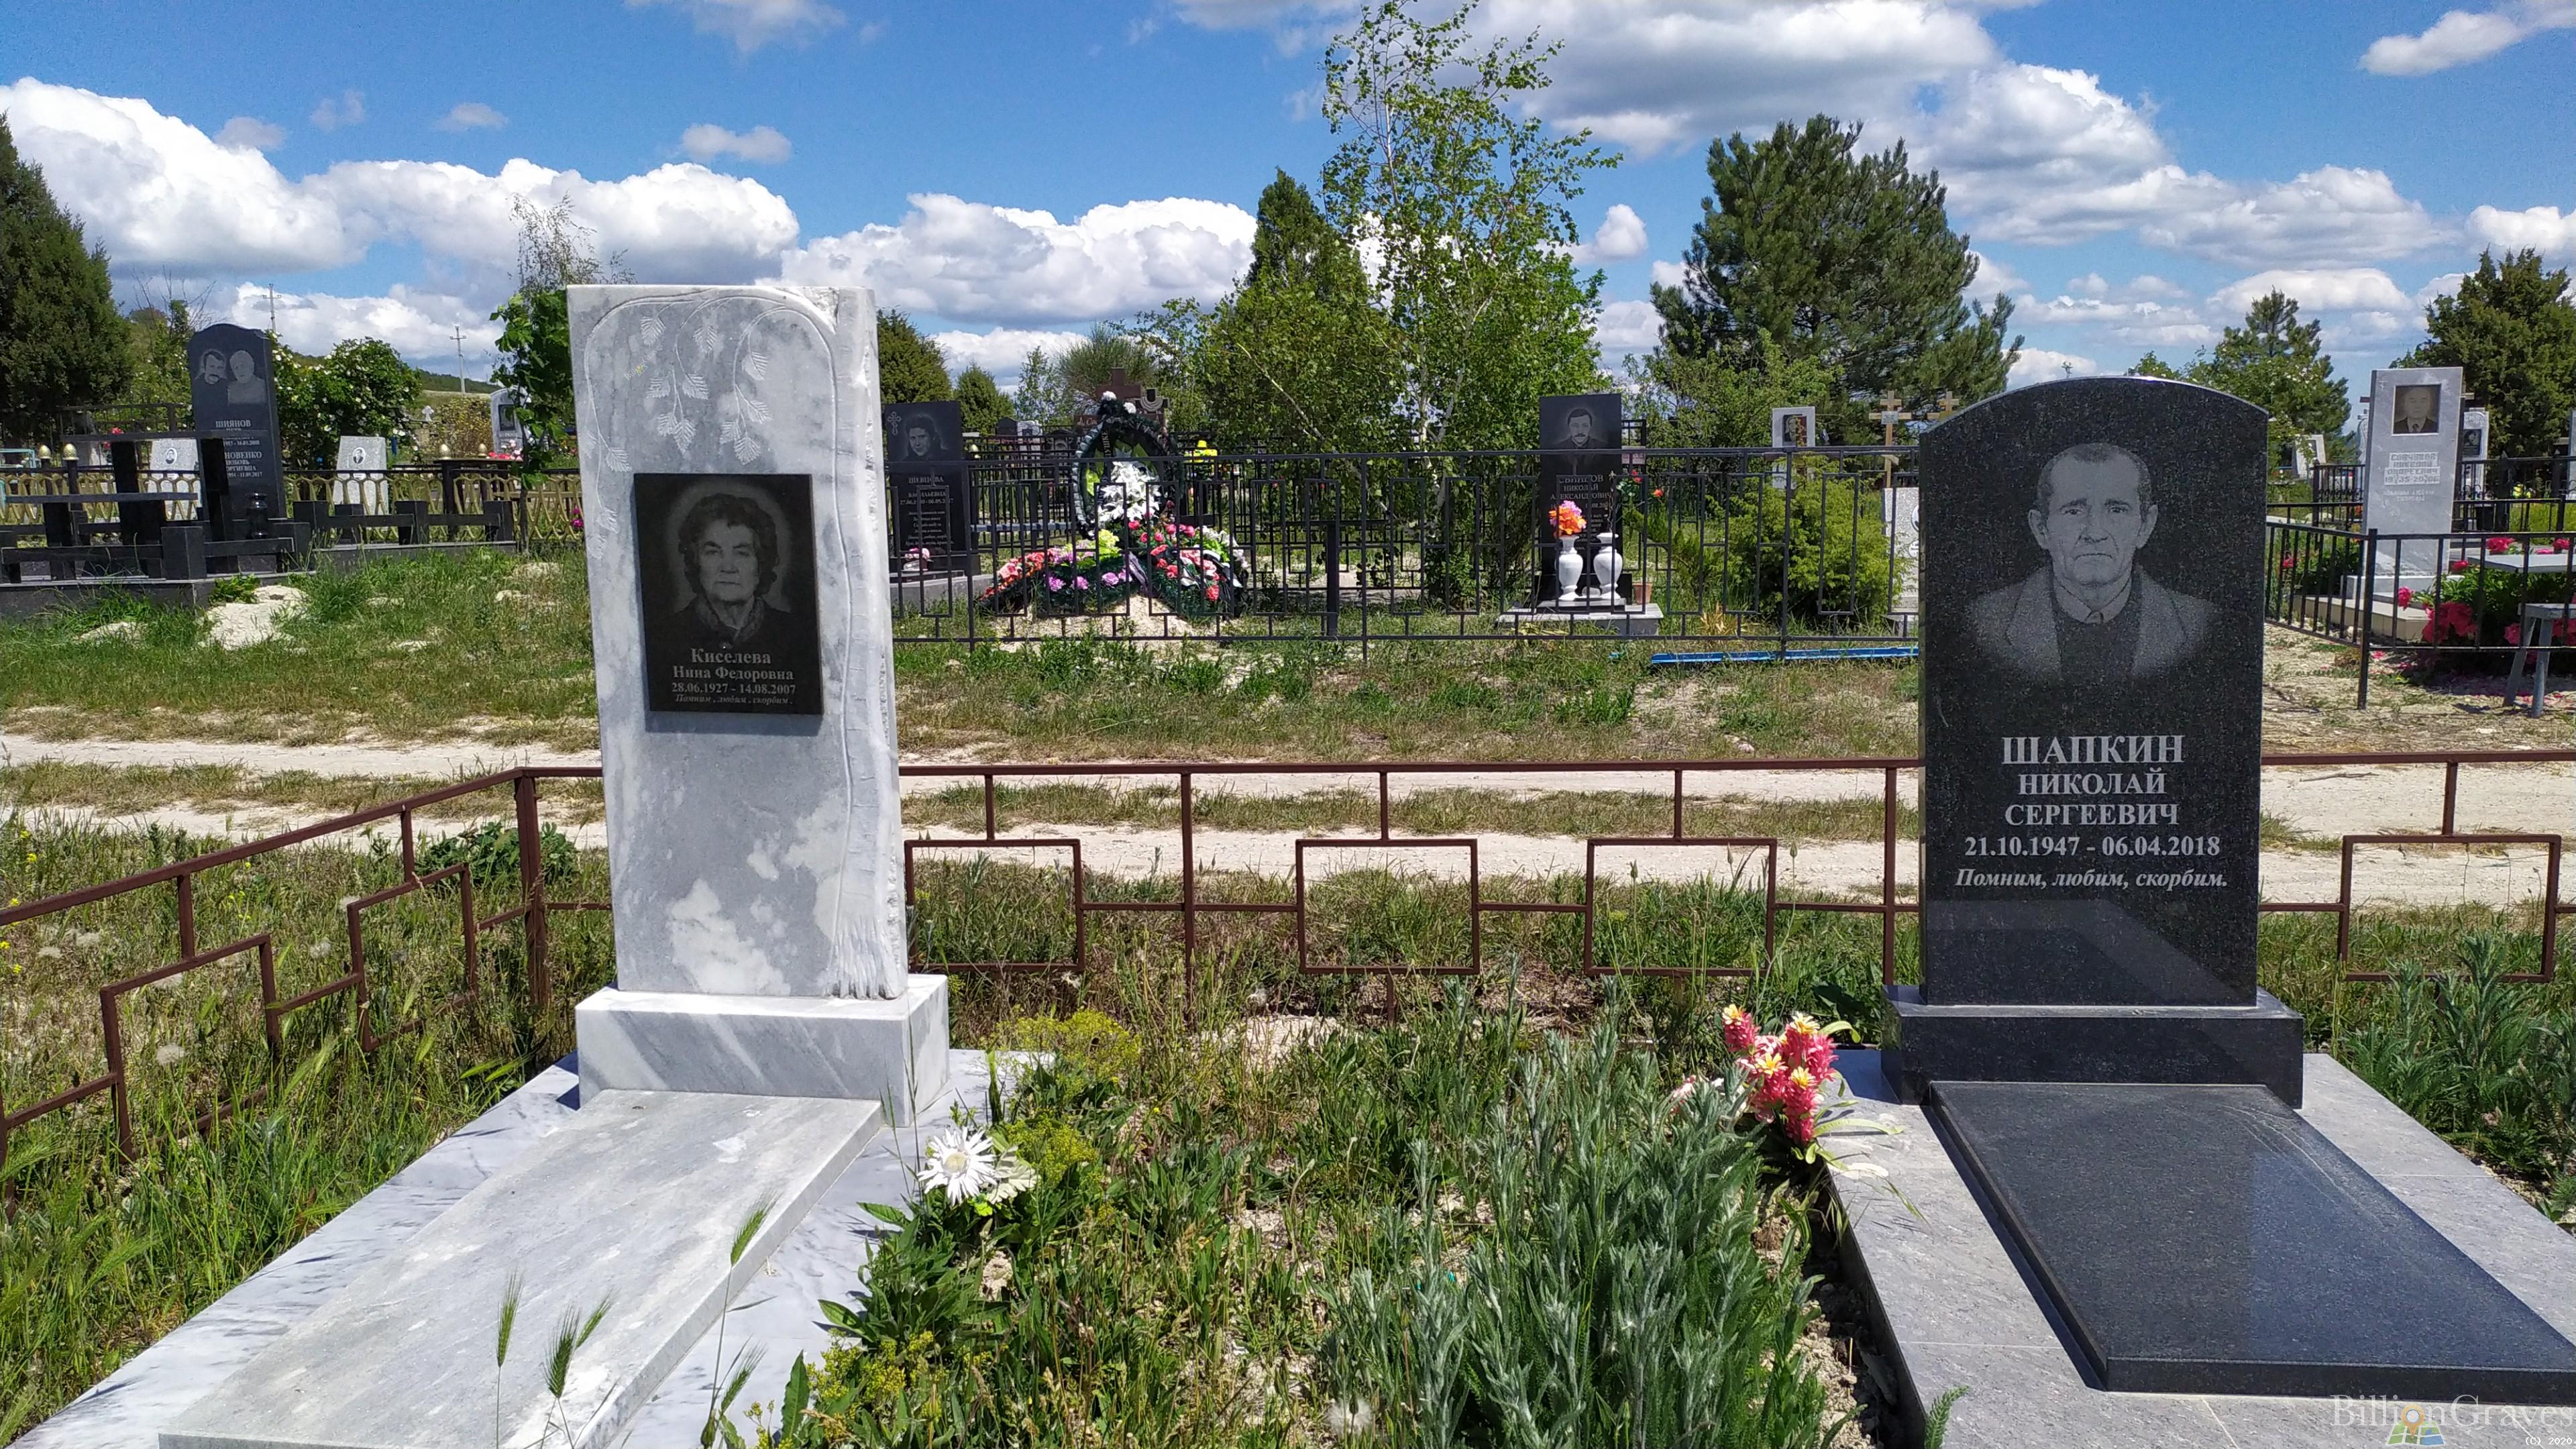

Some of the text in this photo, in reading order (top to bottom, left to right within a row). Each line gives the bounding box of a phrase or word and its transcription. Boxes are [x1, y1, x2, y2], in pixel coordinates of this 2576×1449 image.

[215, 420, 252, 428] ШИЯНОВ
[224, 451, 262, 459] НОВЕНКО
[1564, 483, 1599, 492] НИКОЛЙ
[1551, 492, 1612, 500] АЕКСАНДОВИЧ
[691, 648, 771, 663] Киселева
[673, 665, 794, 682] Нина Федоровна
[672, 682, 728, 692] 28.06.1927
[740, 684, 796, 694] 14.08.2007
[2002, 735, 2185, 765] ШАПКИН
[2018, 767, 2167, 795] НИКОЛАЙ
[2004, 804, 2180, 826] СЕРГЕЕВИЧ
[1965, 836, 2080, 856] 21.10.1947
[2102, 836, 2220, 856] 06.04.2018
[1955, 869, 2228, 892] Помним, любим, скорбим.
